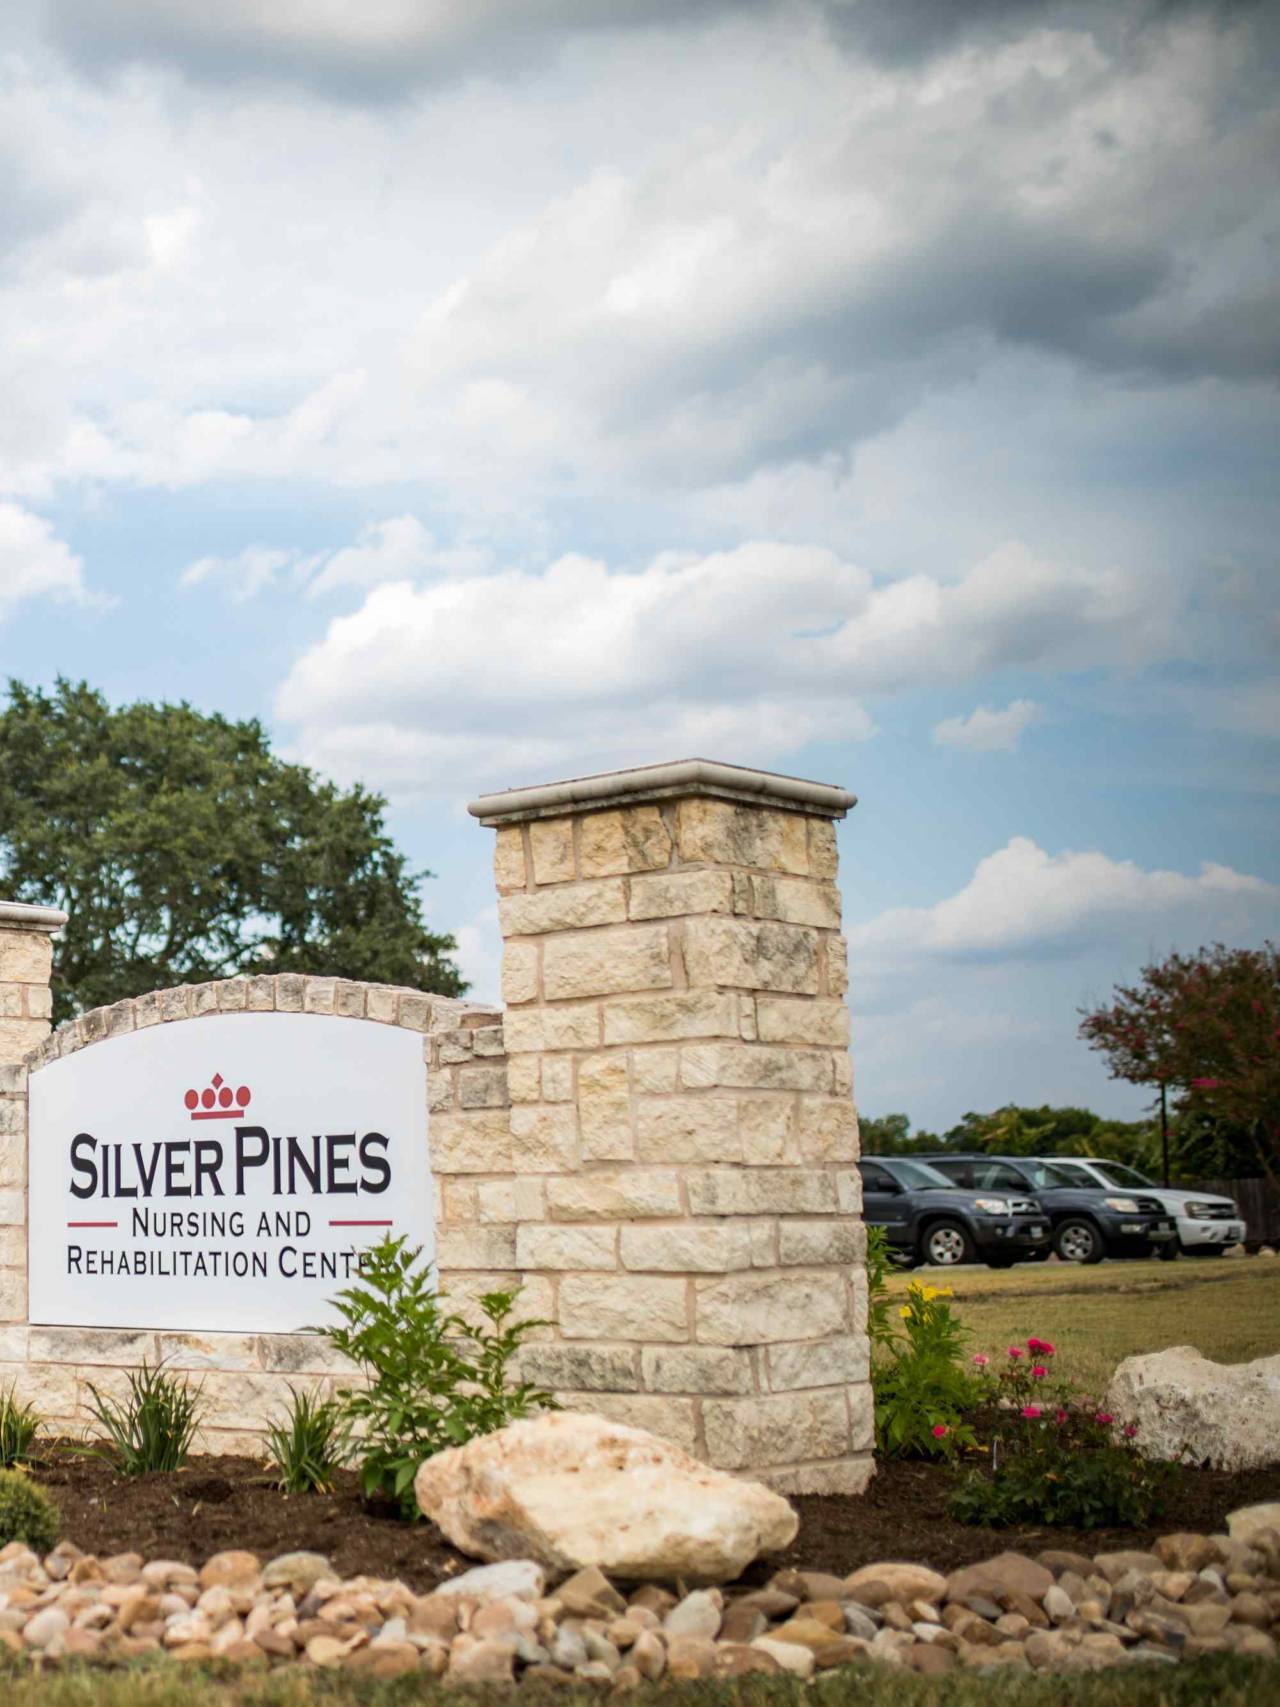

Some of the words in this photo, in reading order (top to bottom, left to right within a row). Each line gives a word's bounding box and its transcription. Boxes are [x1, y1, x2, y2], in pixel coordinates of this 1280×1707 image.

[69, 1132, 225, 1199] SILVER
[233, 1125, 392, 1196] PINES
[132, 1207, 245, 1237] NURSING
[256, 1211, 311, 1237] AND
[67, 1245, 268, 1277] REHABILITATION
